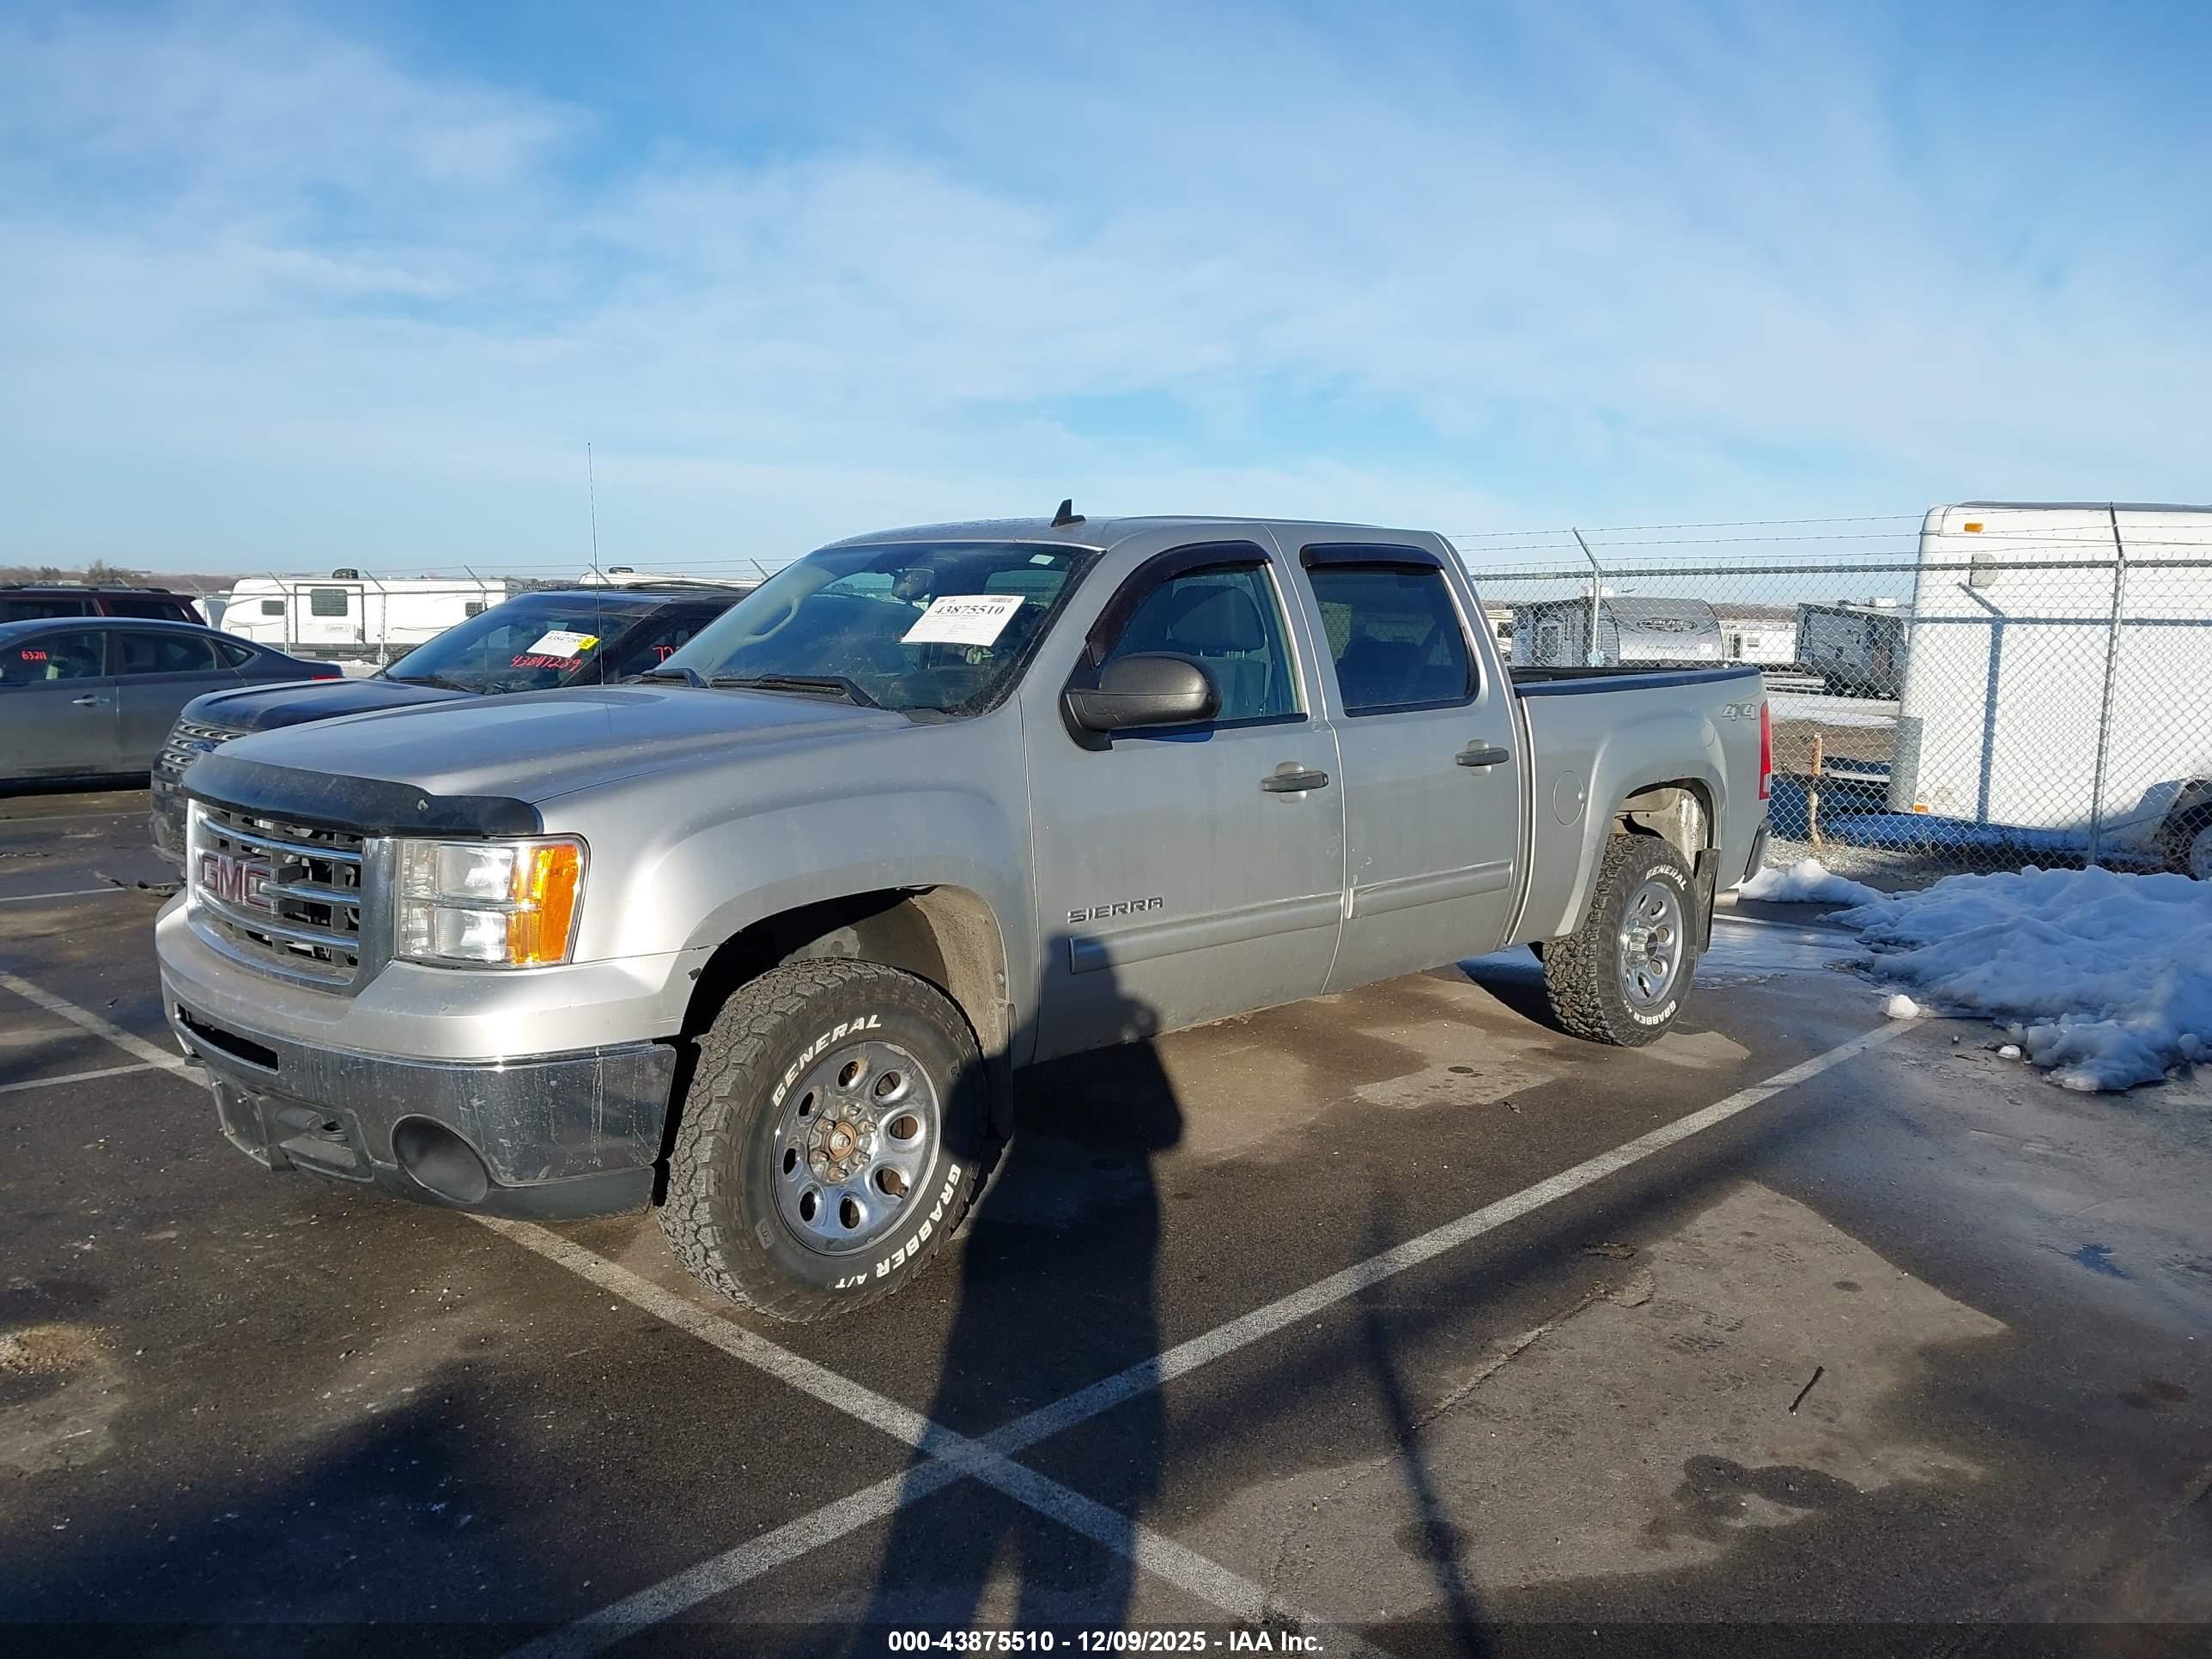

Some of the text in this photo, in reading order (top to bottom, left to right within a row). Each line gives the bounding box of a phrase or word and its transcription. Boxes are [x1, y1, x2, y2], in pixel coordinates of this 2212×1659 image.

[934, 605, 1005, 616] 43875510
[510, 653, 583, 672] 43847289
[203, 849, 279, 915] GMC
[1645, 864, 1688, 891] GENERAL
[1066, 896, 1164, 925] SIERRA
[1633, 1000, 1677, 1025] GRABBER
[772, 1013, 883, 1107] GENERAL
[835, 1164, 962, 1290] GRABBER A/T
